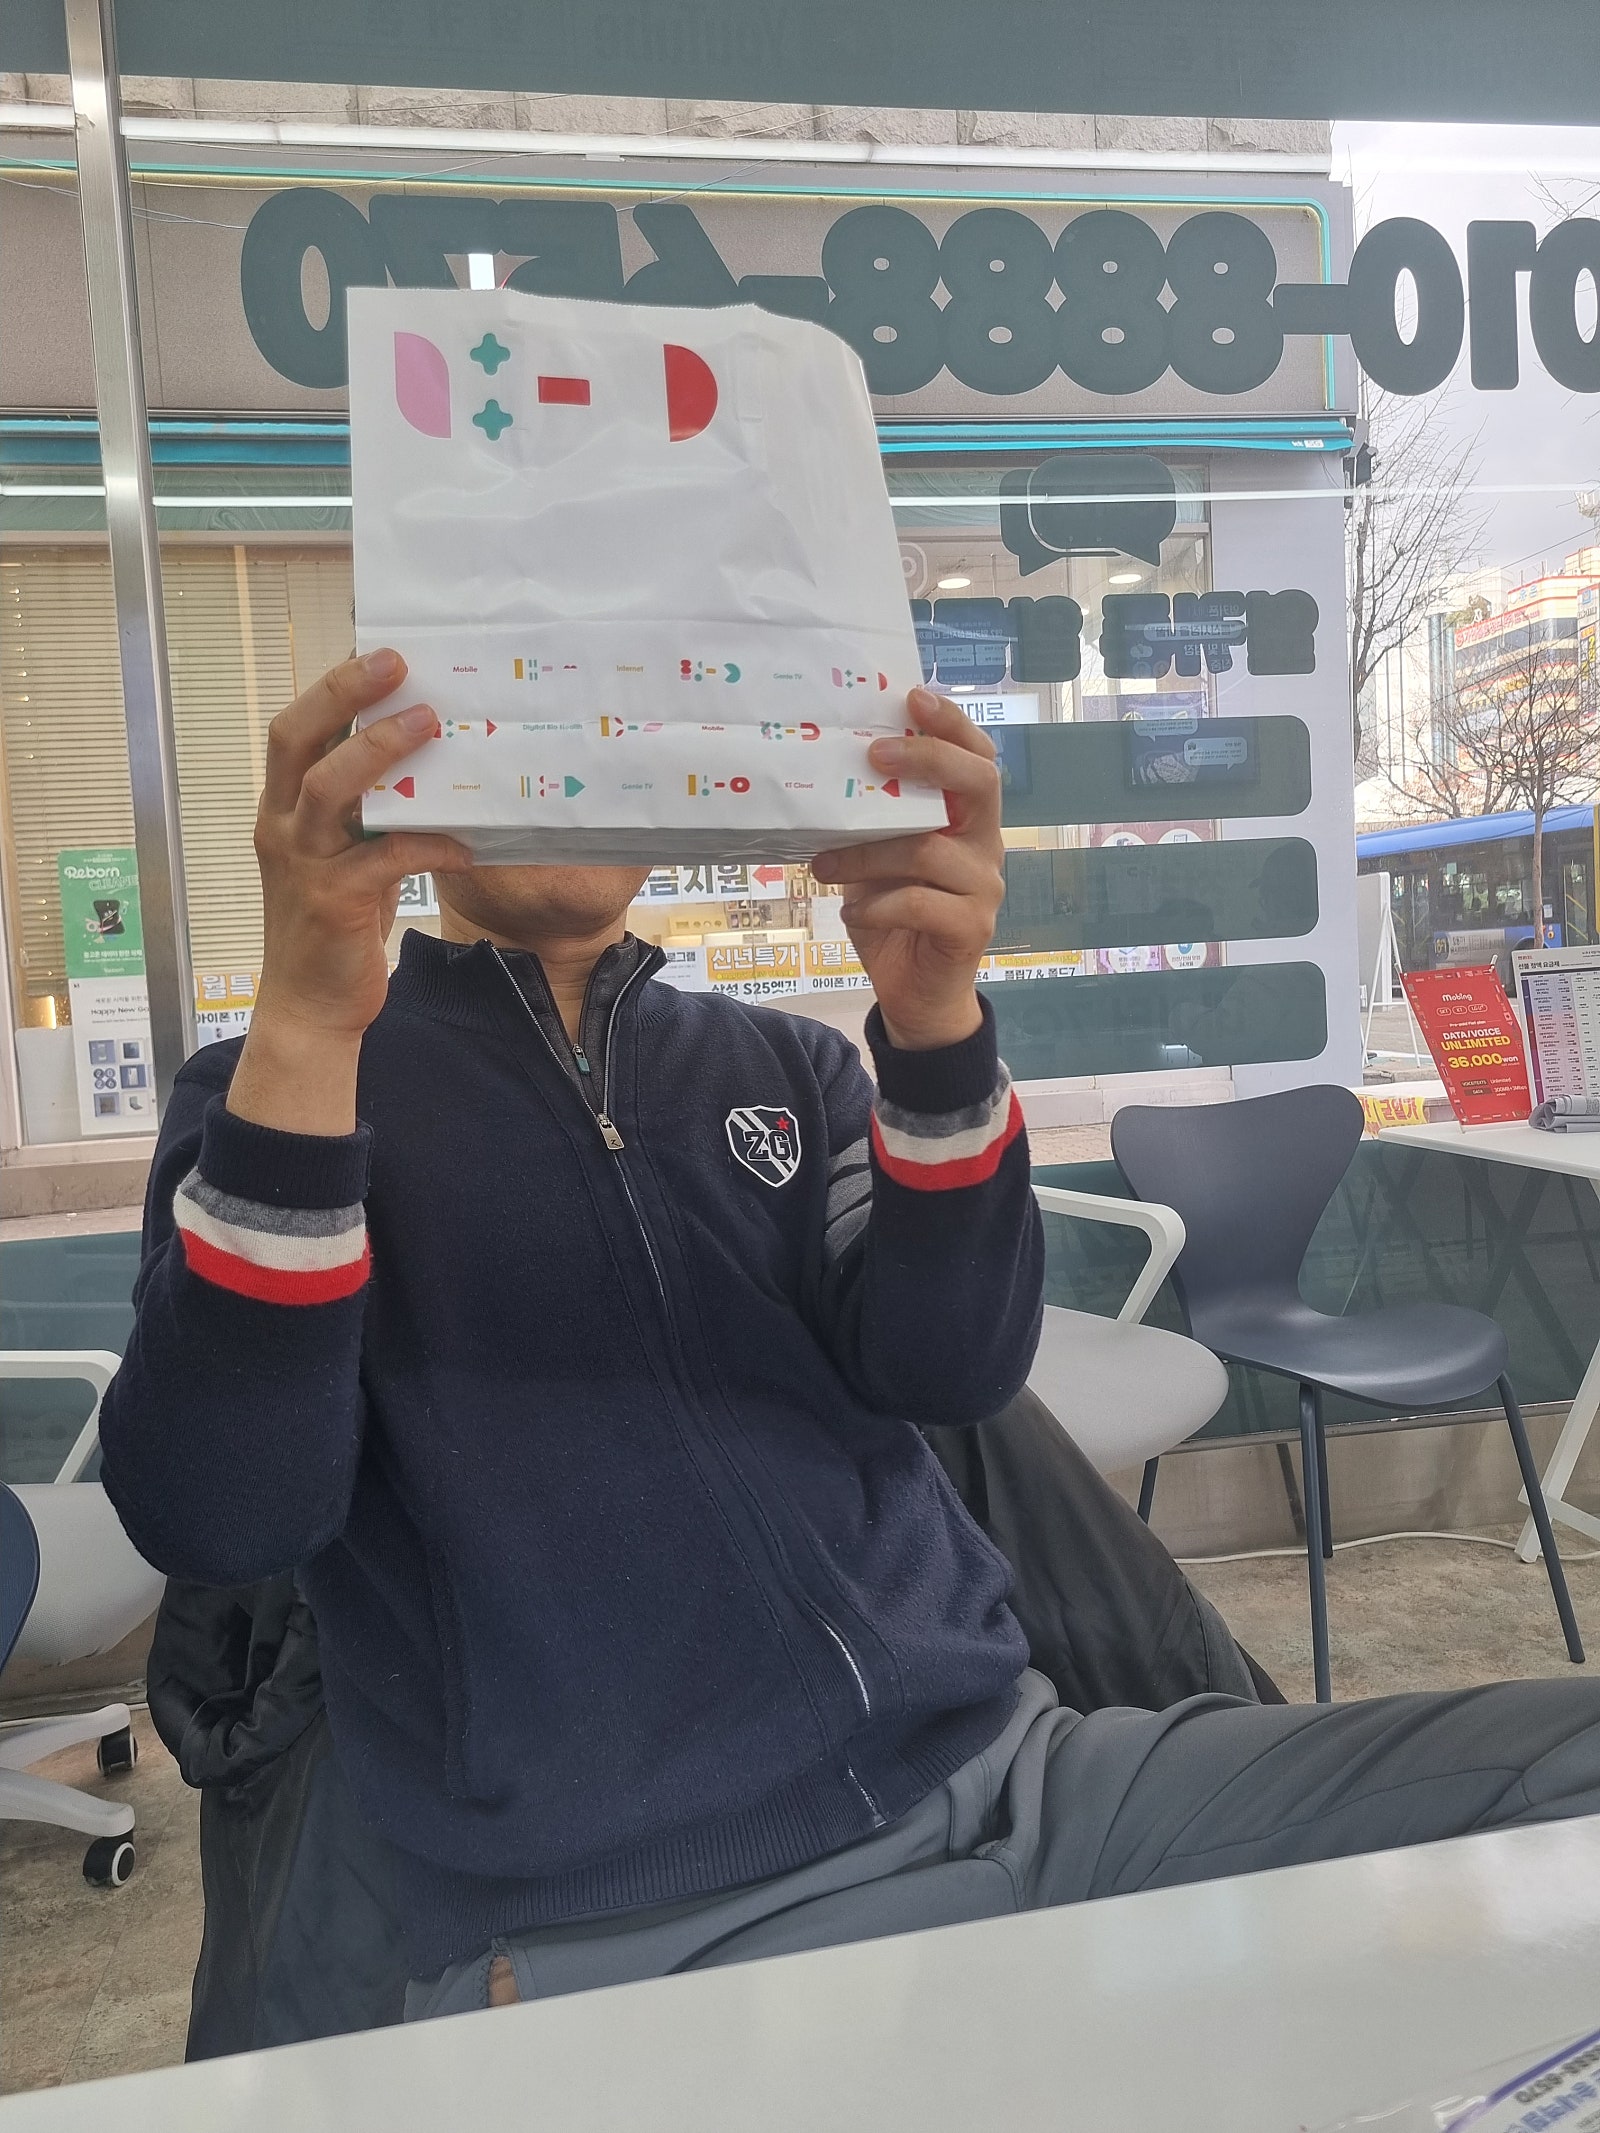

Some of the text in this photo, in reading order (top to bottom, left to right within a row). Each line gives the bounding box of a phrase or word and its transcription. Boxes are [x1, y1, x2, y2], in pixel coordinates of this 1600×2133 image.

[452, 665, 478, 673] Mobile
[616, 665, 644, 673] Internet
[957, 702, 1005, 722] 대로
[452, 783, 481, 791] Internet
[64, 865, 120, 879] Reborn
[639, 865, 749, 897] 금지원
[712, 945, 799, 970] 신년특가
[848, 977, 858, 987] 17
[1442, 1027, 1502, 1041] DATA/VOICE
[1440, 1035, 1512, 1052] UNLIMITED
[1447, 1053, 1502, 1069] 36,000
[743, 1129, 793, 1161] ZG
